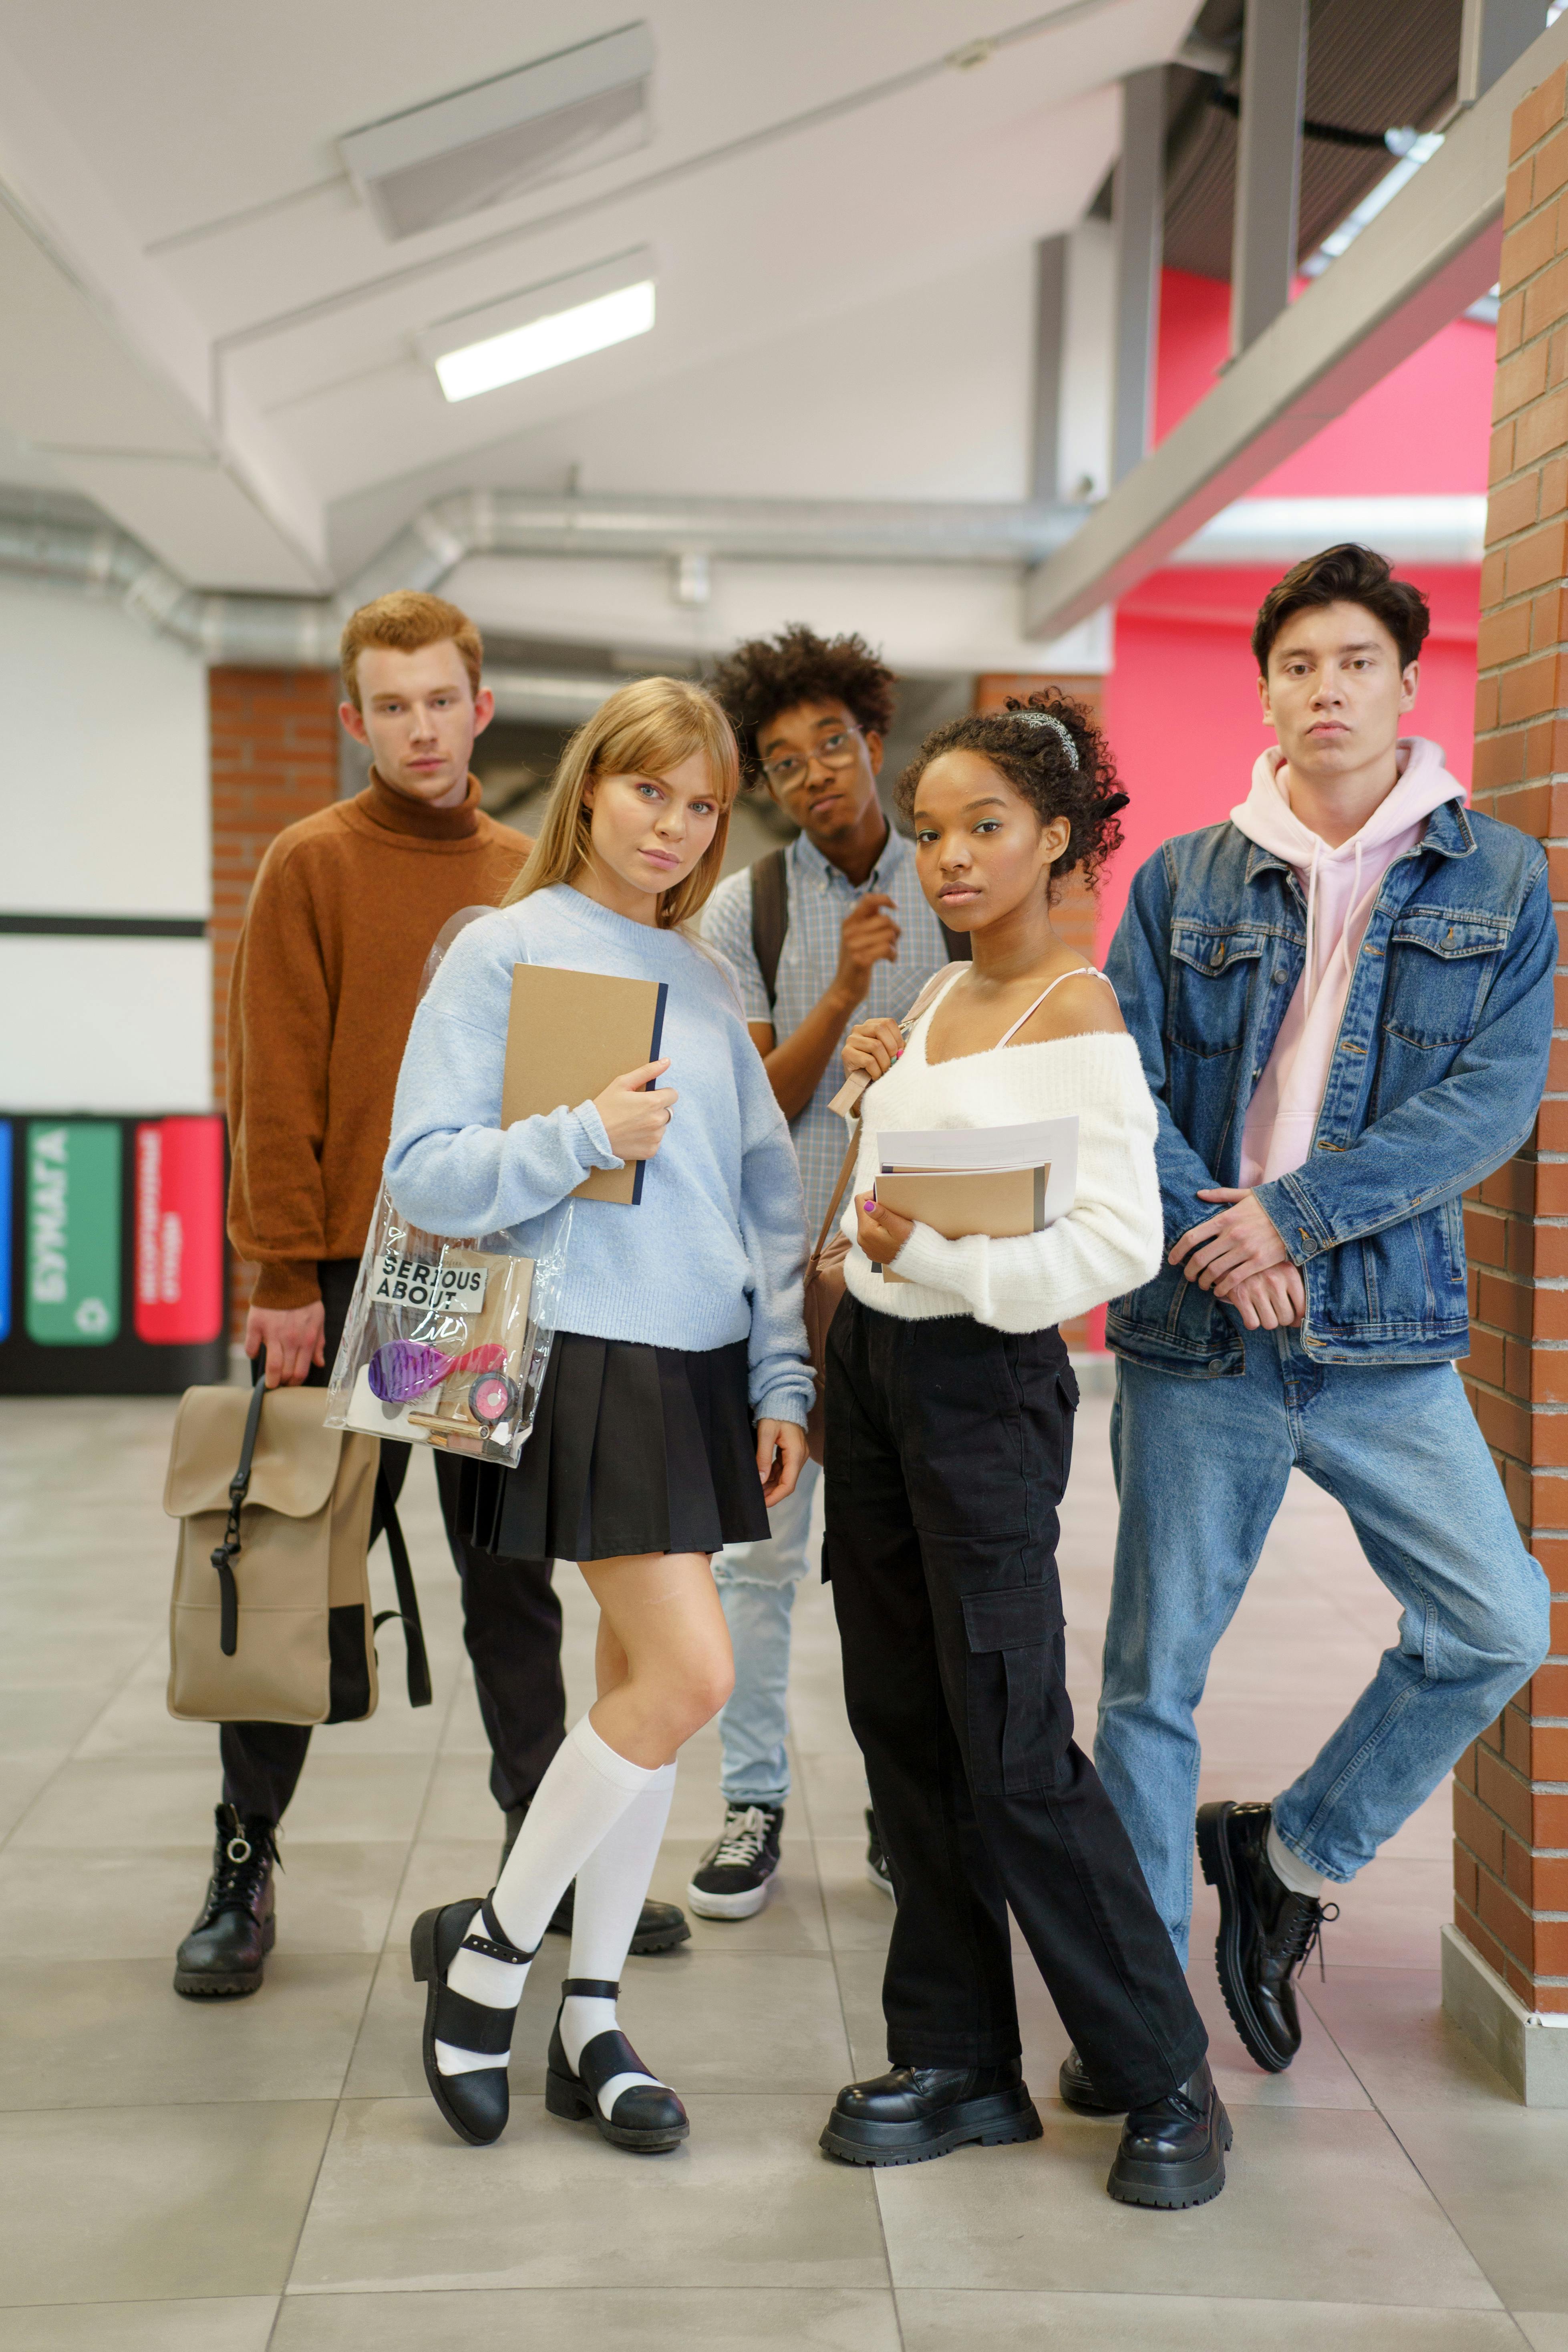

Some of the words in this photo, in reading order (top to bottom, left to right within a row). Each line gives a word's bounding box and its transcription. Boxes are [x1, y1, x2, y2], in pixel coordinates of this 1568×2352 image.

[33, 1126, 67, 1303] БУМАГА
[383, 1257, 481, 1291] SERIOUS
[376, 1278, 457, 1310] ABOUT
